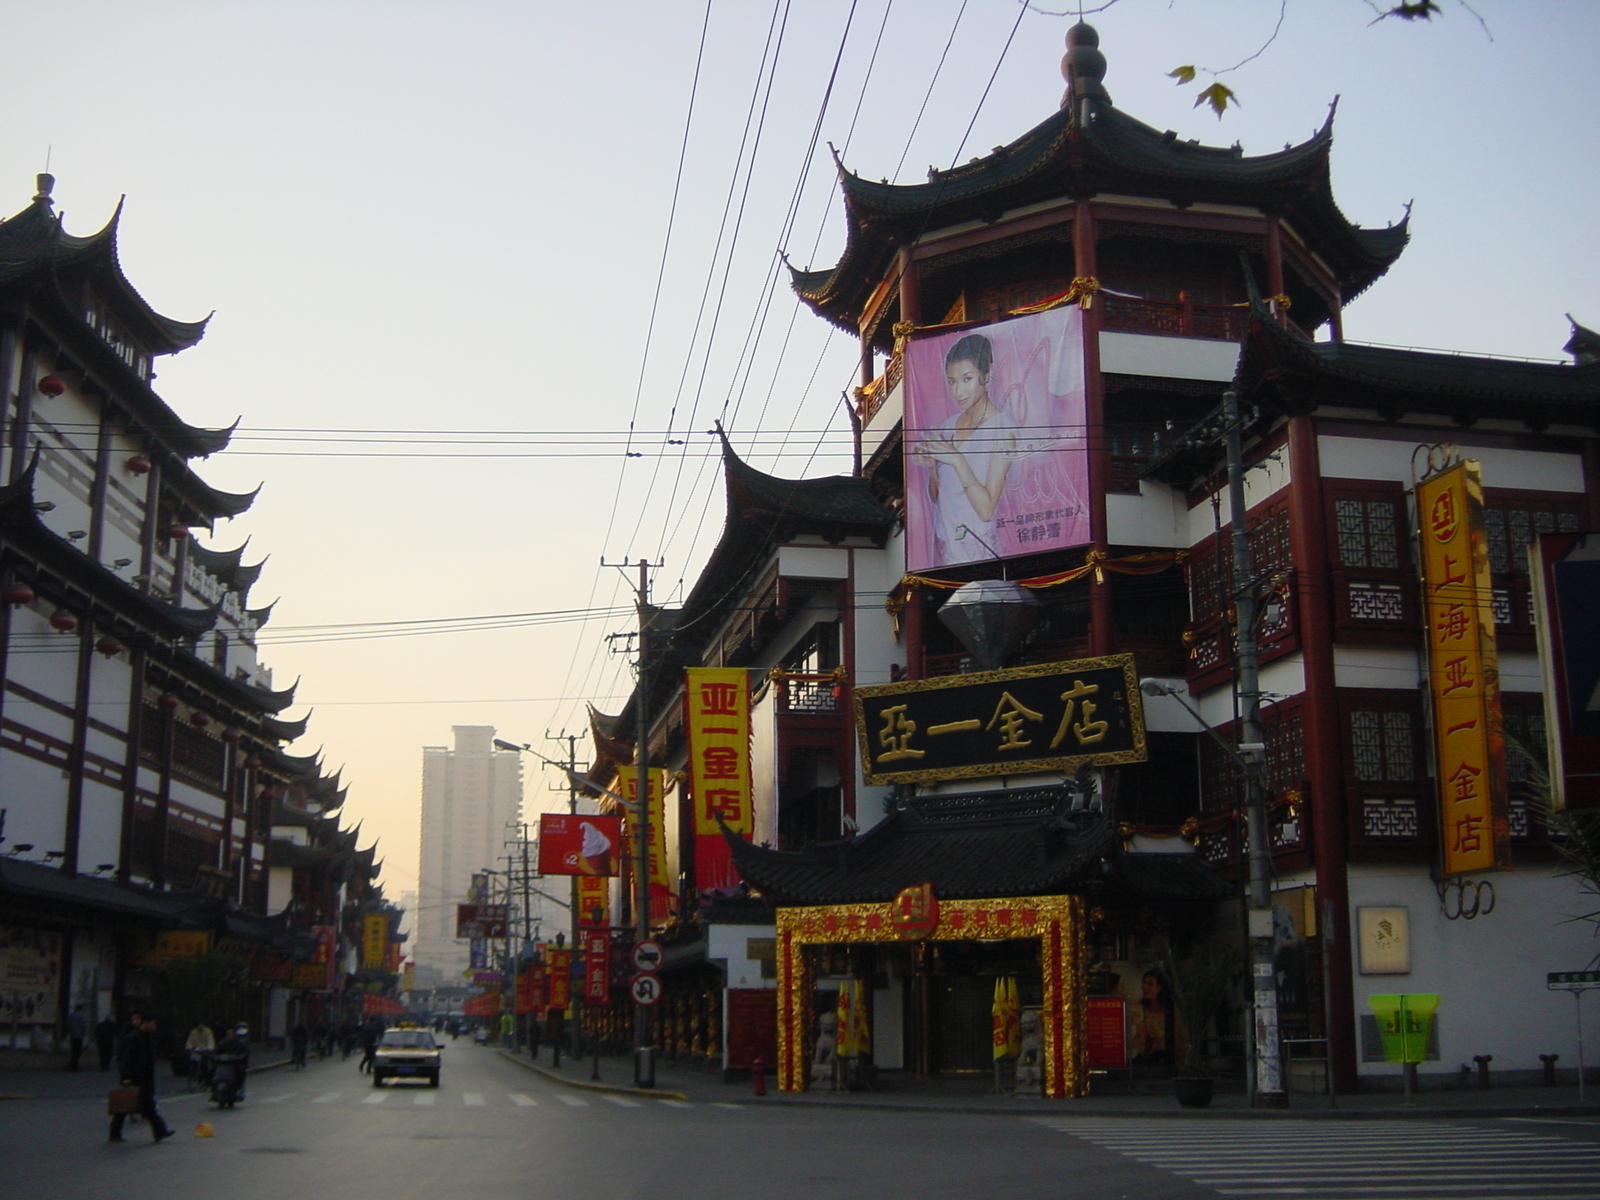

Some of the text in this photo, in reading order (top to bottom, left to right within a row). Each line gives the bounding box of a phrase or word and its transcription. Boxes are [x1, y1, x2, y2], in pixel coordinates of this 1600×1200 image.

[701, 682, 742, 821] 亚一金店
[876, 680, 1108, 763] 亞一金店
[1436, 554, 1483, 853] 上海亚一金店
